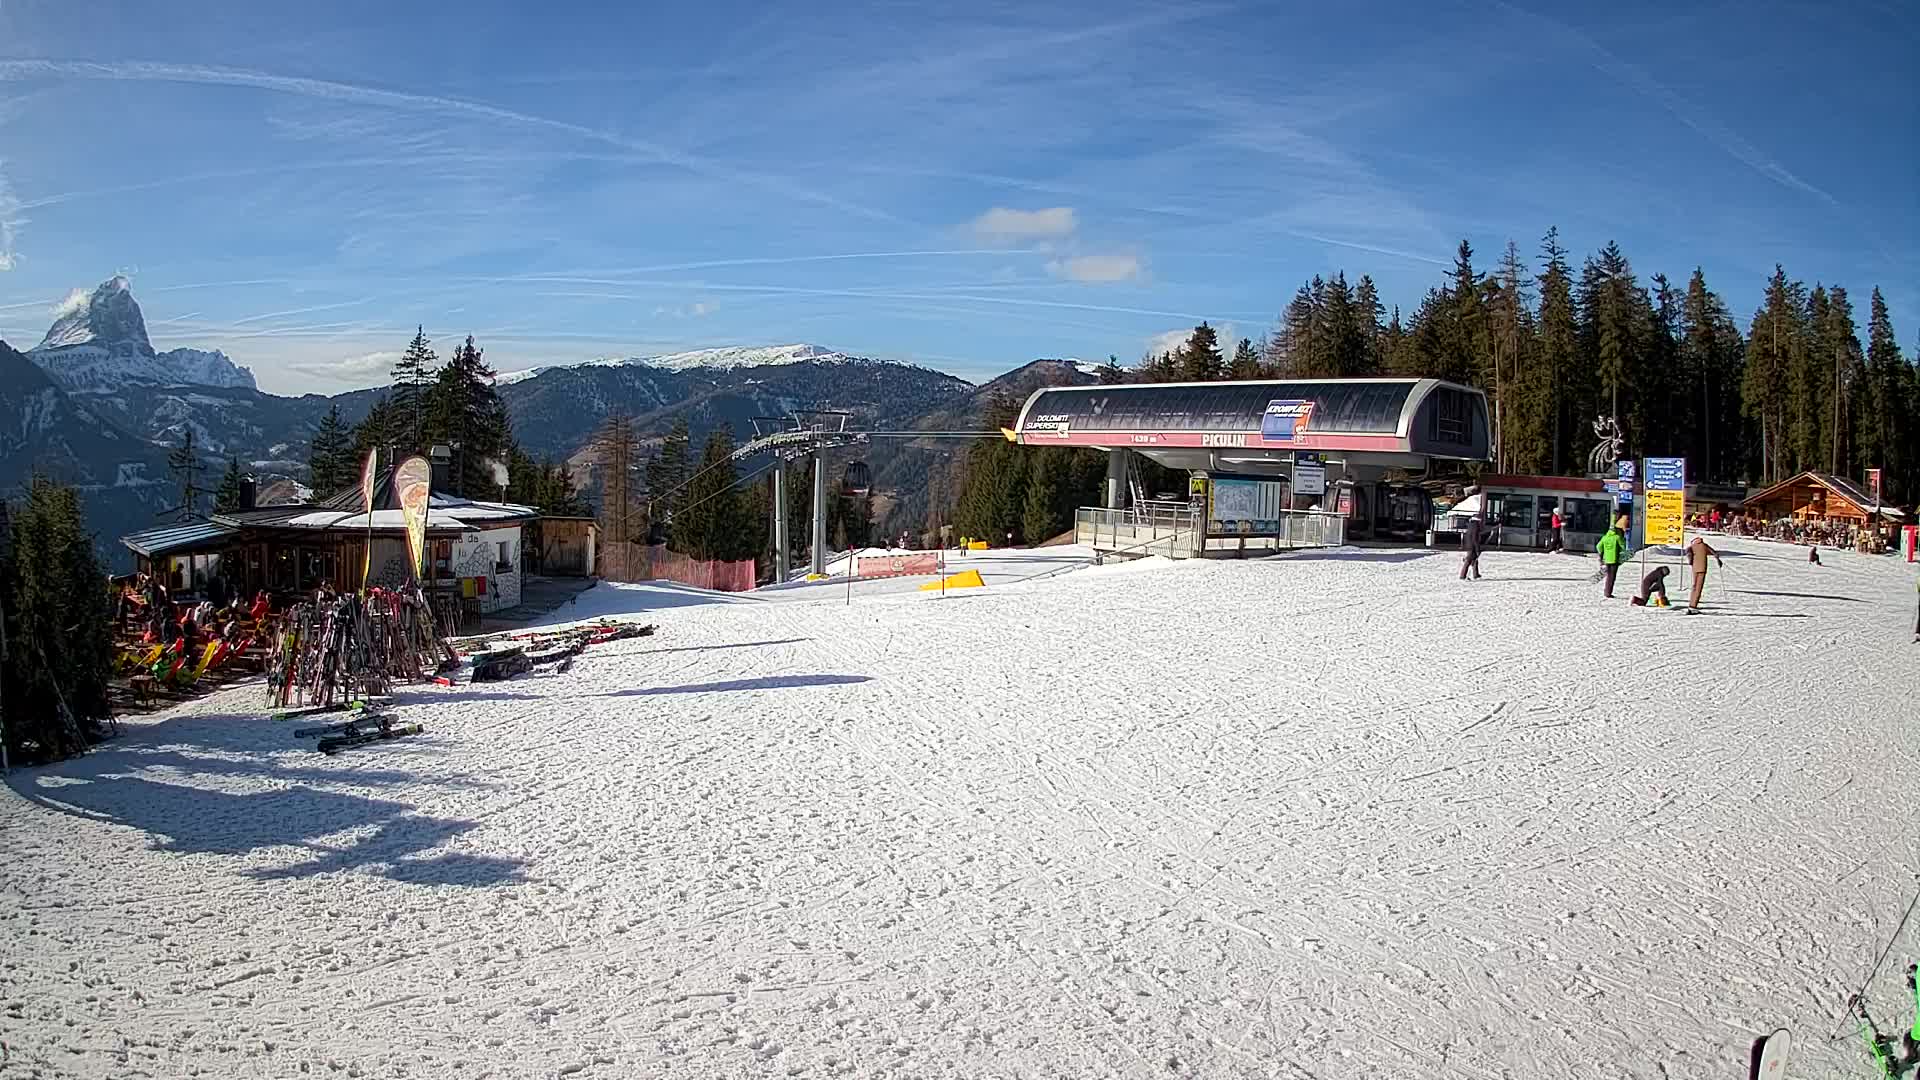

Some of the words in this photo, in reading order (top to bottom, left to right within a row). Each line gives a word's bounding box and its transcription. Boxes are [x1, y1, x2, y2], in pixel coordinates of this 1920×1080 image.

[1037, 414, 1069, 422] DOLOMITI
[1026, 422, 1059, 430] SUPERSKI
[1202, 434, 1246, 447] PICULIN
